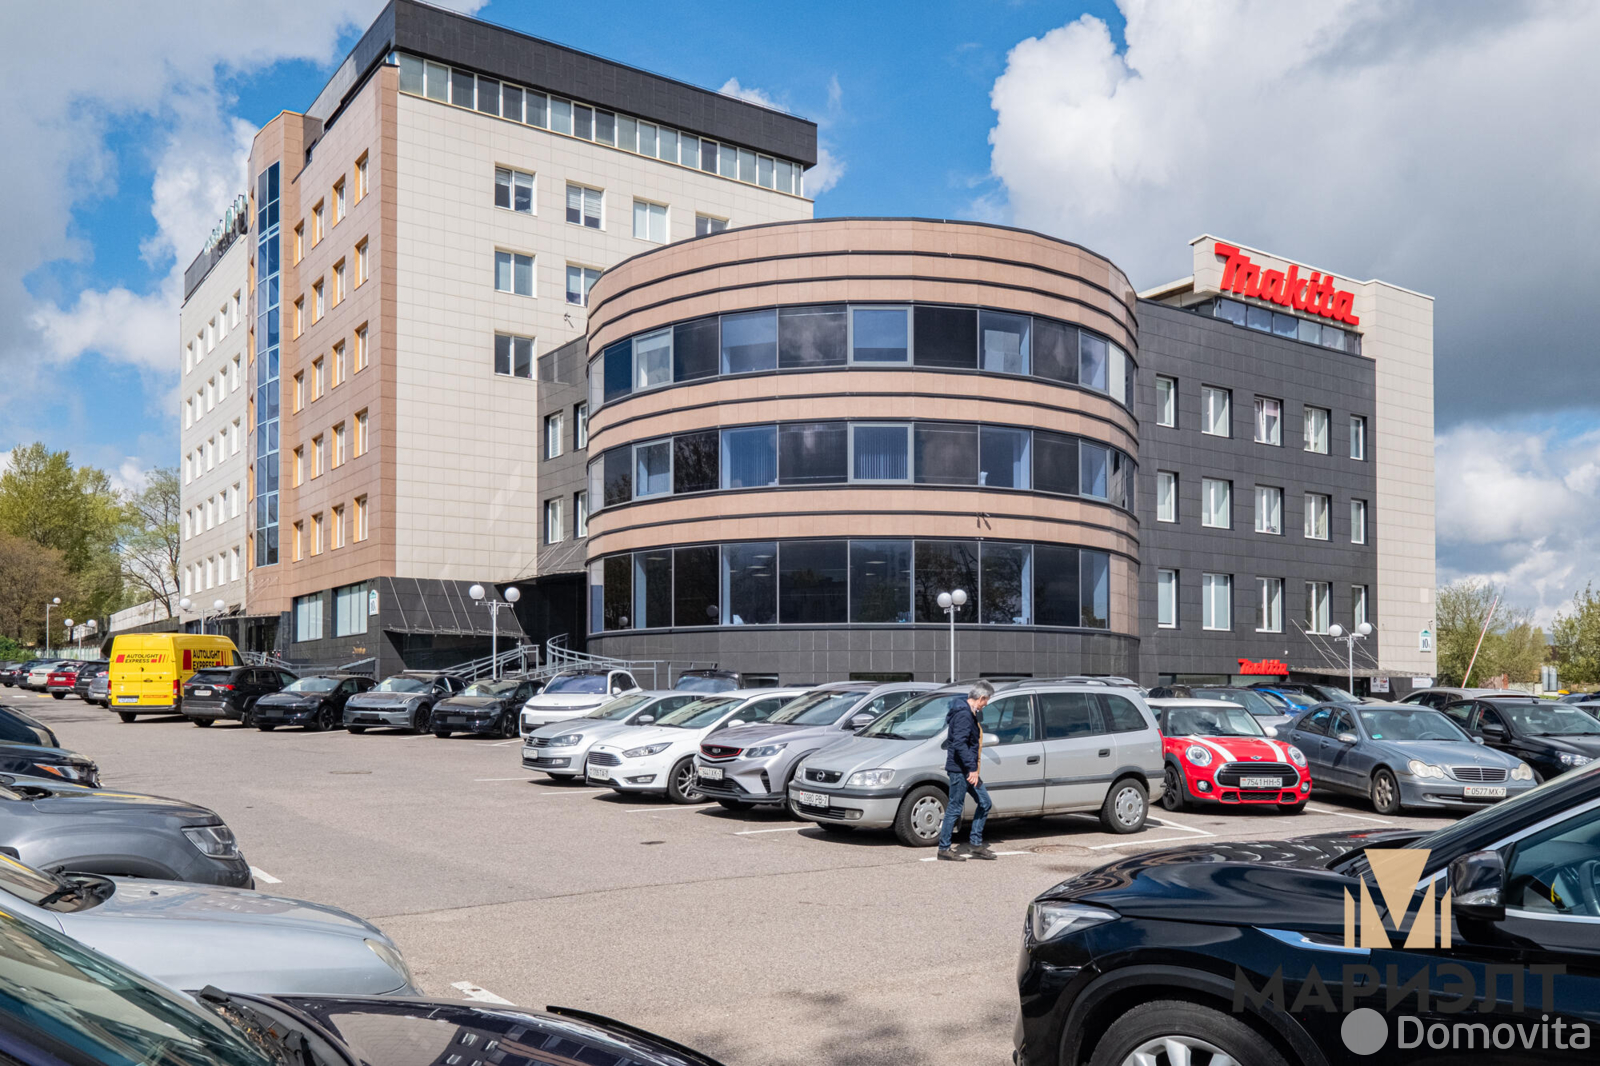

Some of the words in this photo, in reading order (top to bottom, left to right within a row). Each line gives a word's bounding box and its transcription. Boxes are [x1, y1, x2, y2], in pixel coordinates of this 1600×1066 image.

[1214, 242, 1359, 326] Makita
[193, 649, 220, 659] AUTOLIGHT
[1238, 658, 1289, 676] Makita
[1471, 787, 1488, 795] 0577
